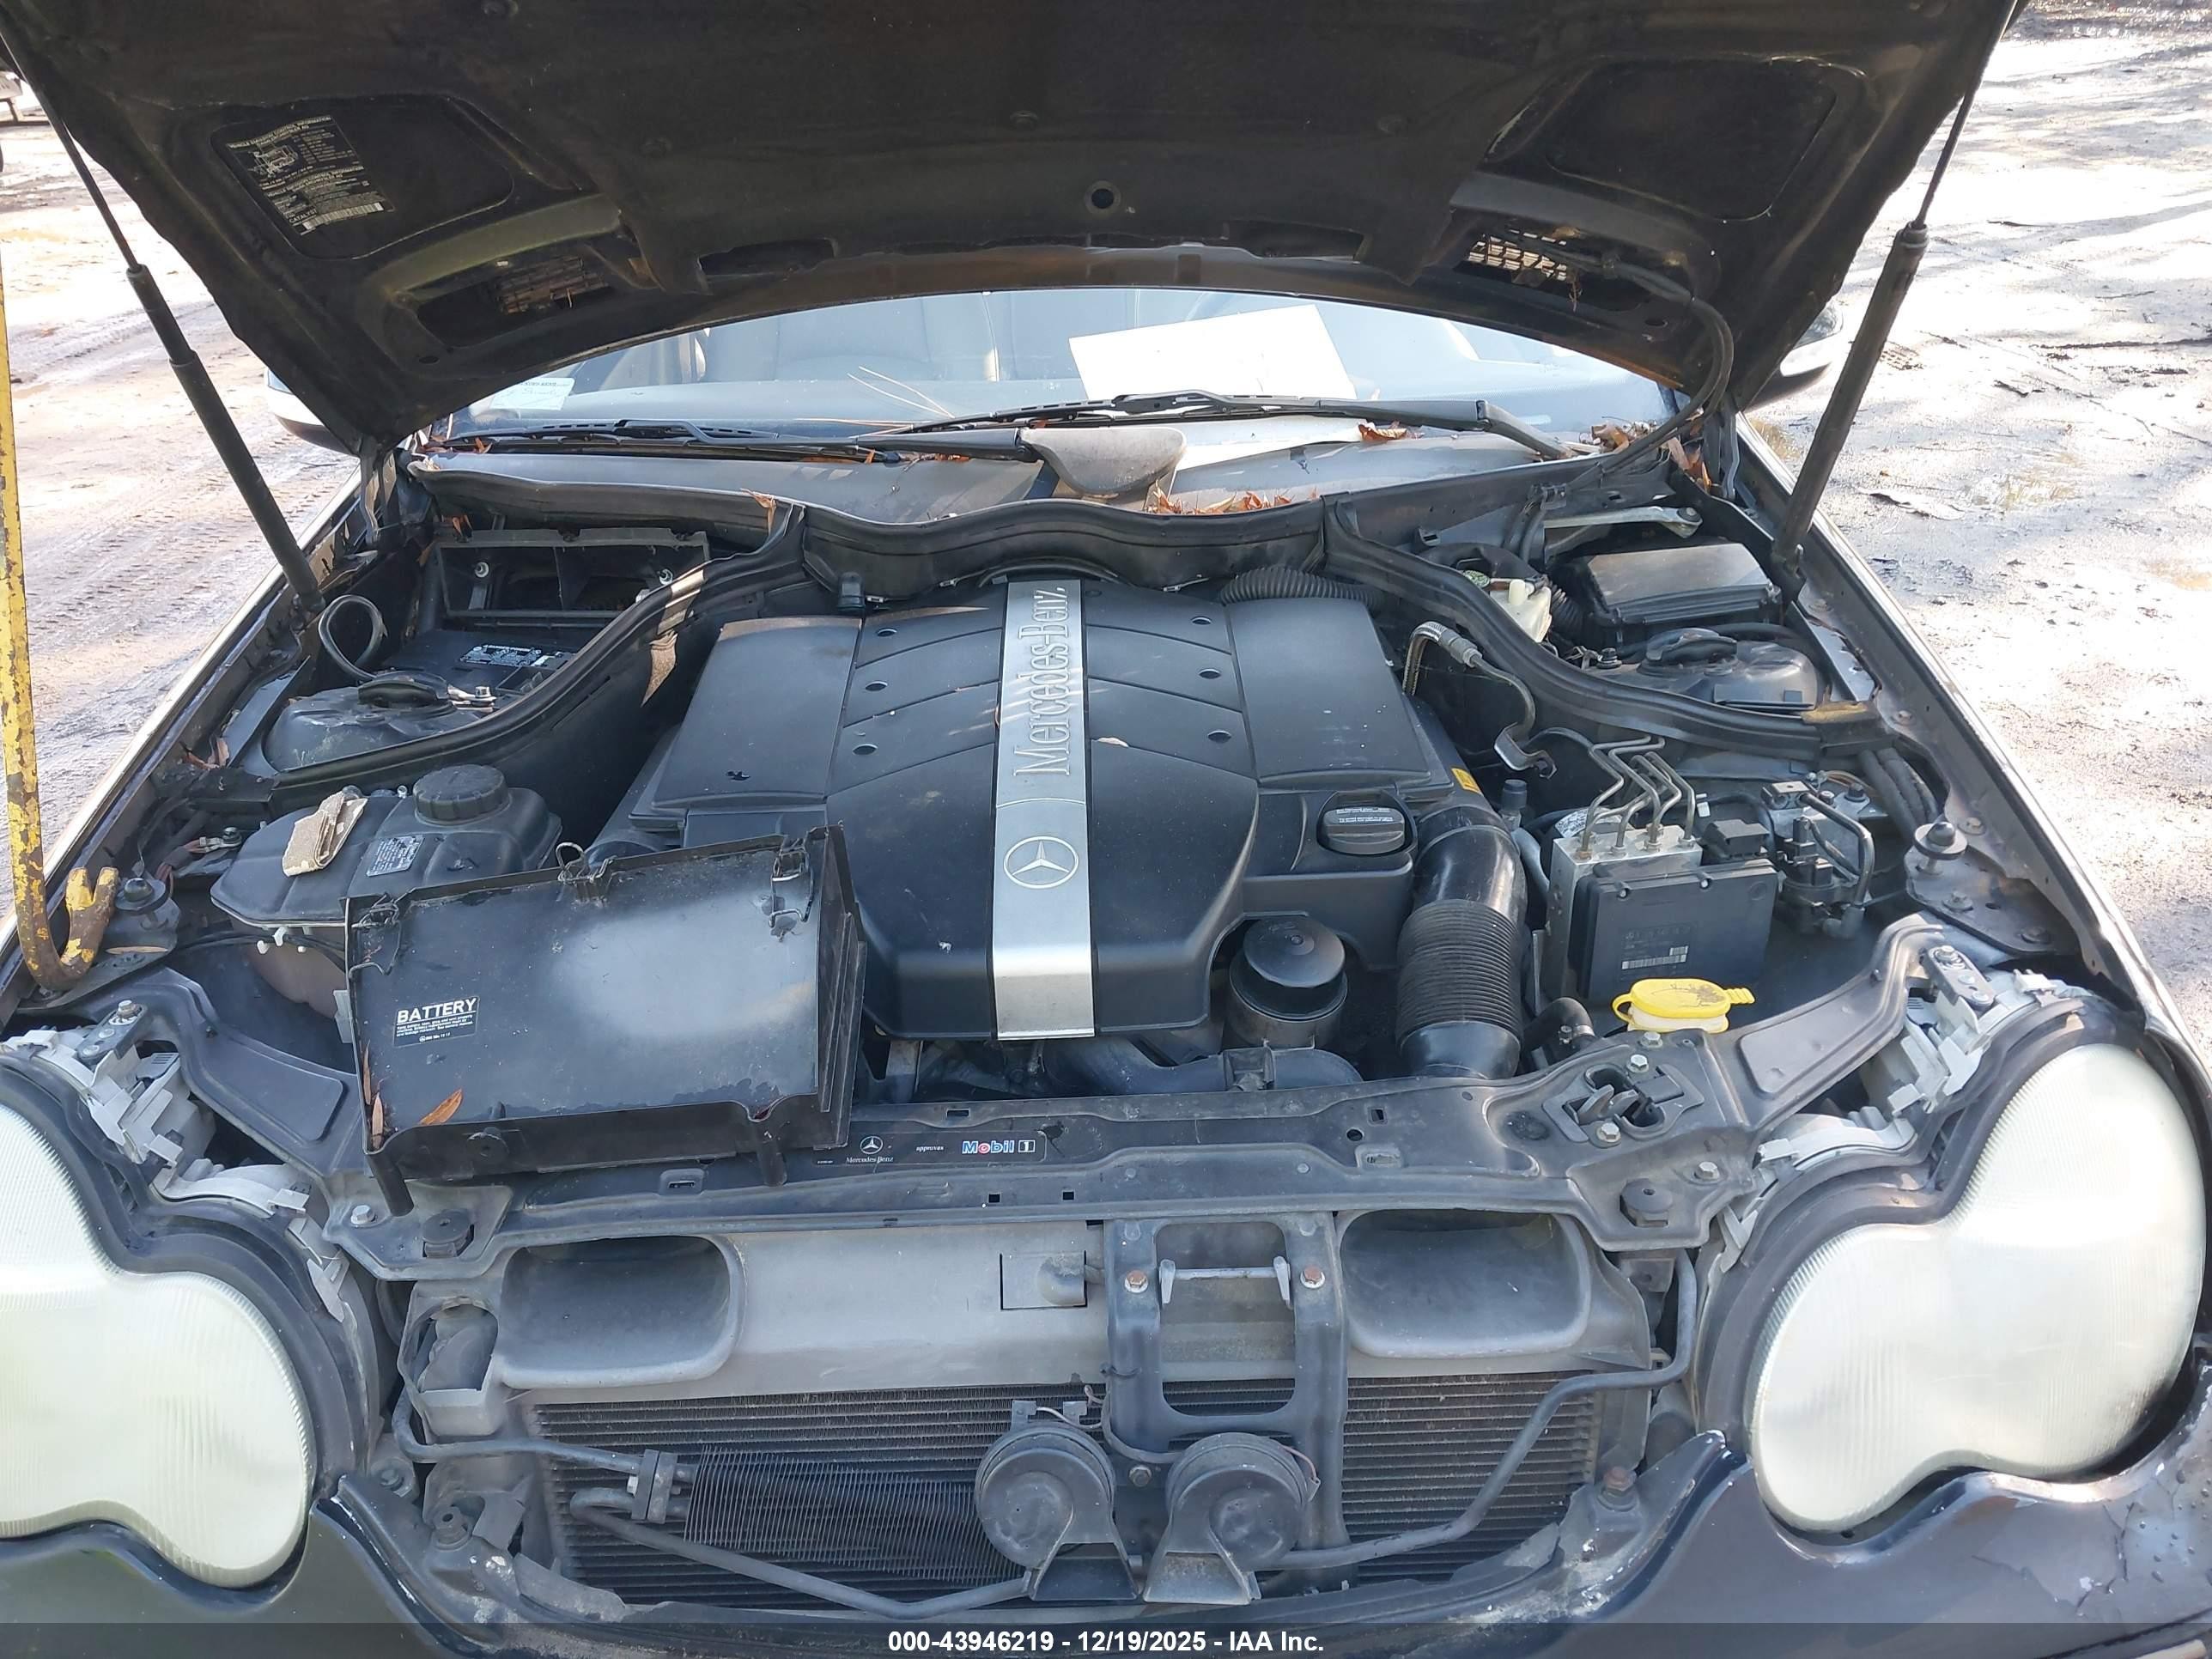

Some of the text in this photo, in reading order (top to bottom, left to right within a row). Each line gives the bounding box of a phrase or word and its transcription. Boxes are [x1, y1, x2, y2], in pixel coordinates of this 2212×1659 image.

[289, 209, 317, 223] CATALYST
[1013, 586, 1070, 776] Mercedes-Benz
[397, 998, 477, 1024] BATTERY
[962, 1140, 1015, 1153] Mobil
